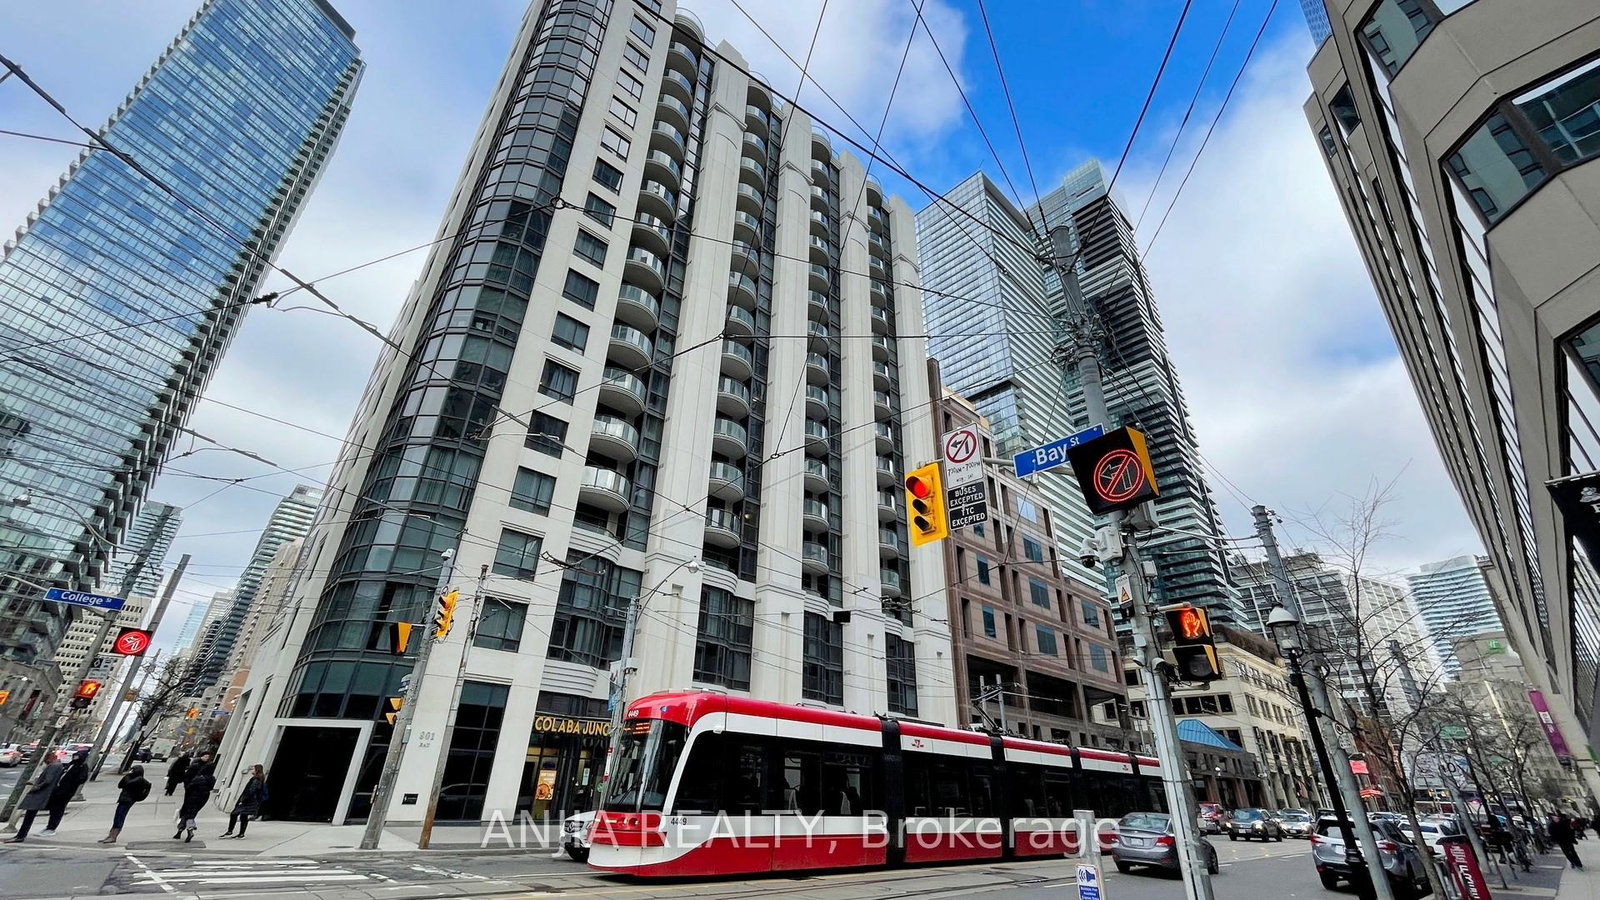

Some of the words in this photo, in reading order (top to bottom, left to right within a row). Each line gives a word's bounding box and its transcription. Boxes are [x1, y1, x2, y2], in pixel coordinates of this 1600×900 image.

[1036, 444, 1067, 465] Bay
[1070, 436, 1080, 447] St
[955, 486, 977, 497] BUSES
[950, 492, 984, 507] EXCEPTED
[961, 507, 975, 516] TTC
[952, 513, 986, 527] EXCEPTED
[61, 591, 103, 605] College
[535, 716, 580, 734] COLABA
